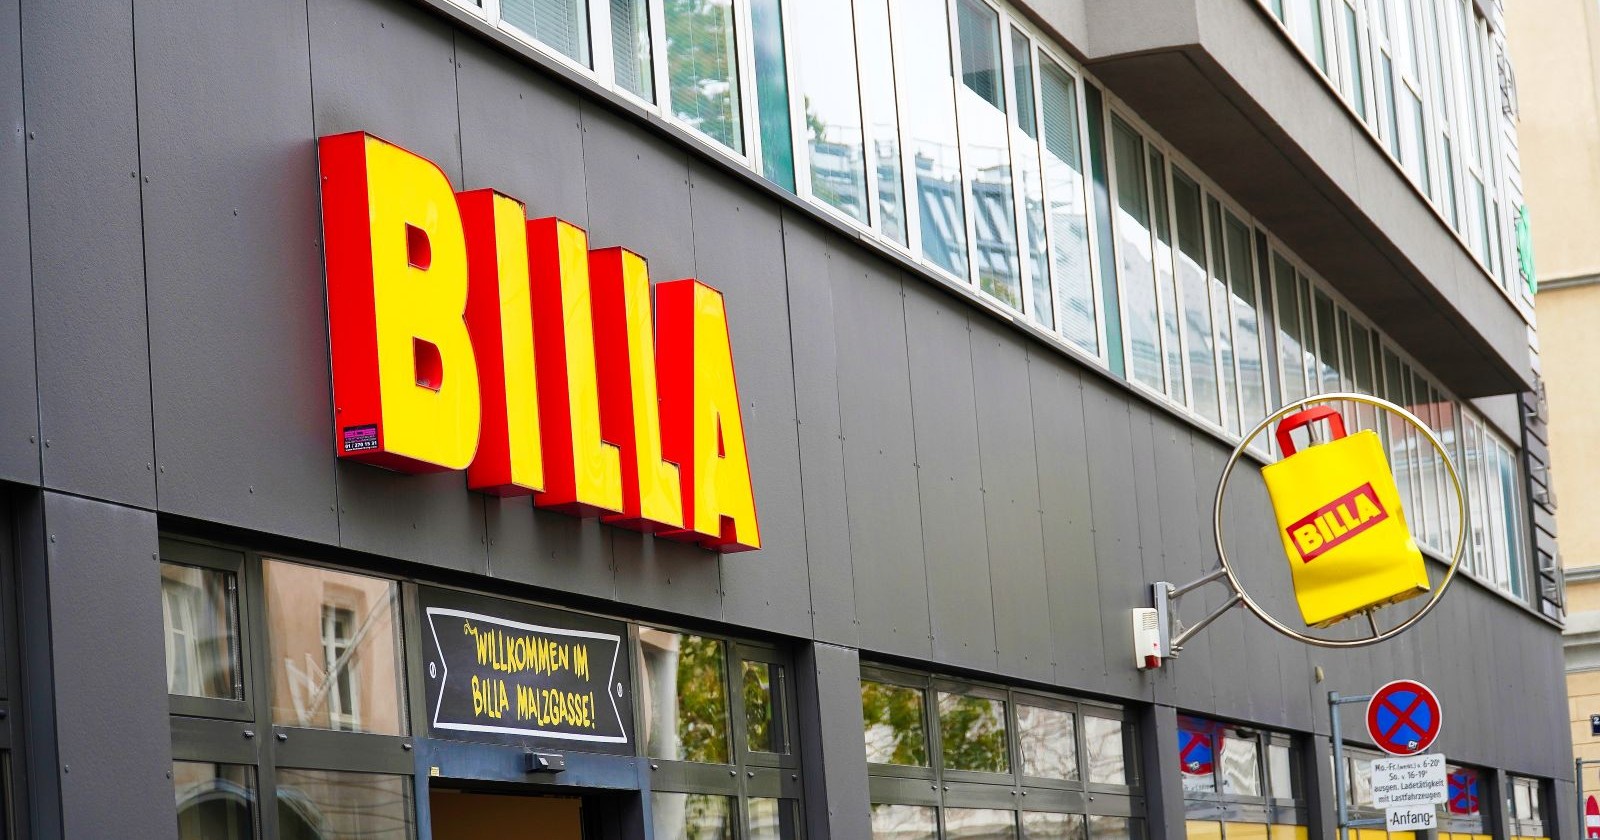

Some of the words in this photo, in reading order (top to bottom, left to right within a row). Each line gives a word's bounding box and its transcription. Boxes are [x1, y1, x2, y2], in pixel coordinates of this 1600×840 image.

[319, 131, 762, 553] BILLA
[1293, 492, 1382, 555] BILLA
[464, 620, 569, 677] WILLKOMMEN
[573, 643, 590, 682] IM
[471, 675, 510, 719] BILLA
[517, 683, 596, 729] MALZGASSE!
[1374, 784, 1399, 793] ausgen.
[1401, 779, 1444, 790] Ladetätigkeit
[1378, 793, 1390, 803] mit
[1391, 790, 1441, 803] Lastfahrzeugen
